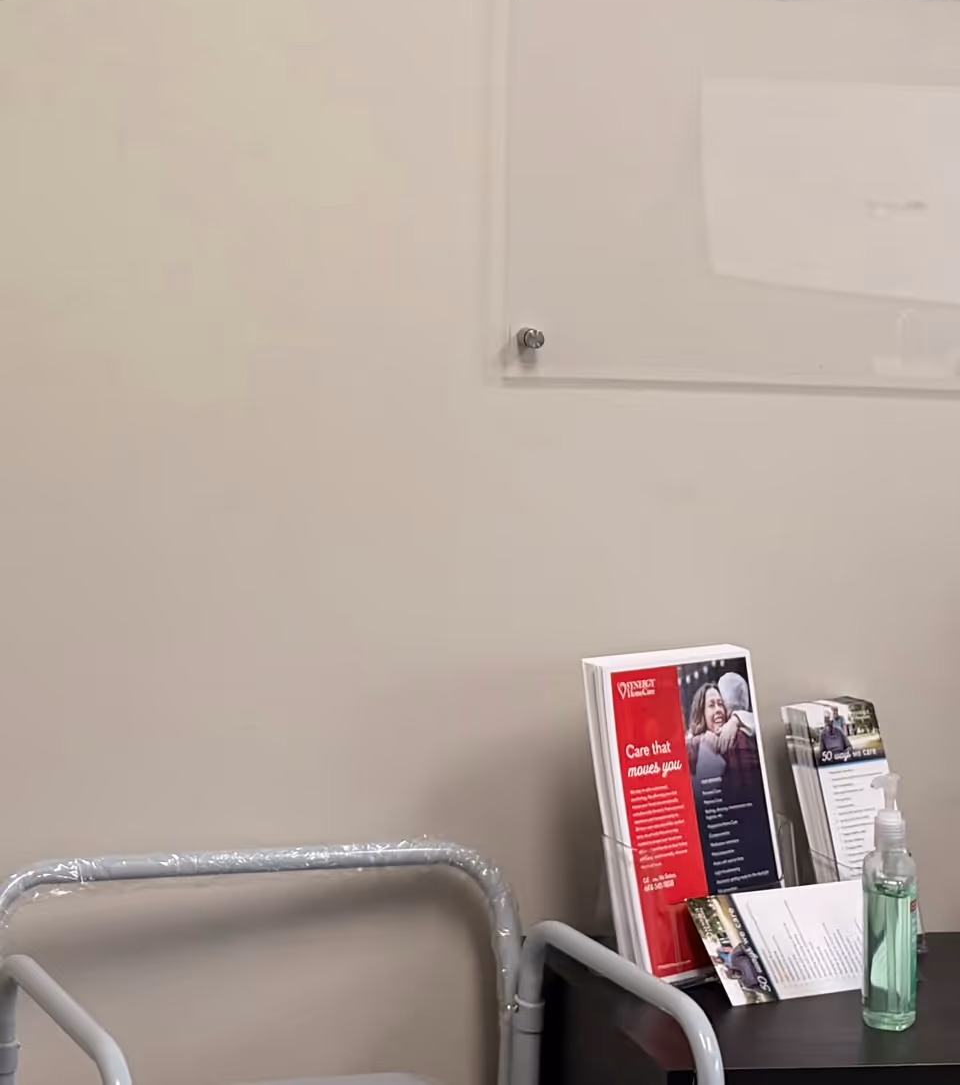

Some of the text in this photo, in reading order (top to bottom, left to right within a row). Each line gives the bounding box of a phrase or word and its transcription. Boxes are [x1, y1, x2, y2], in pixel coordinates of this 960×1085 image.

[625, 740, 672, 760] Care that
[821, 750, 833, 762] 50
[627, 758, 683, 779] moves you
